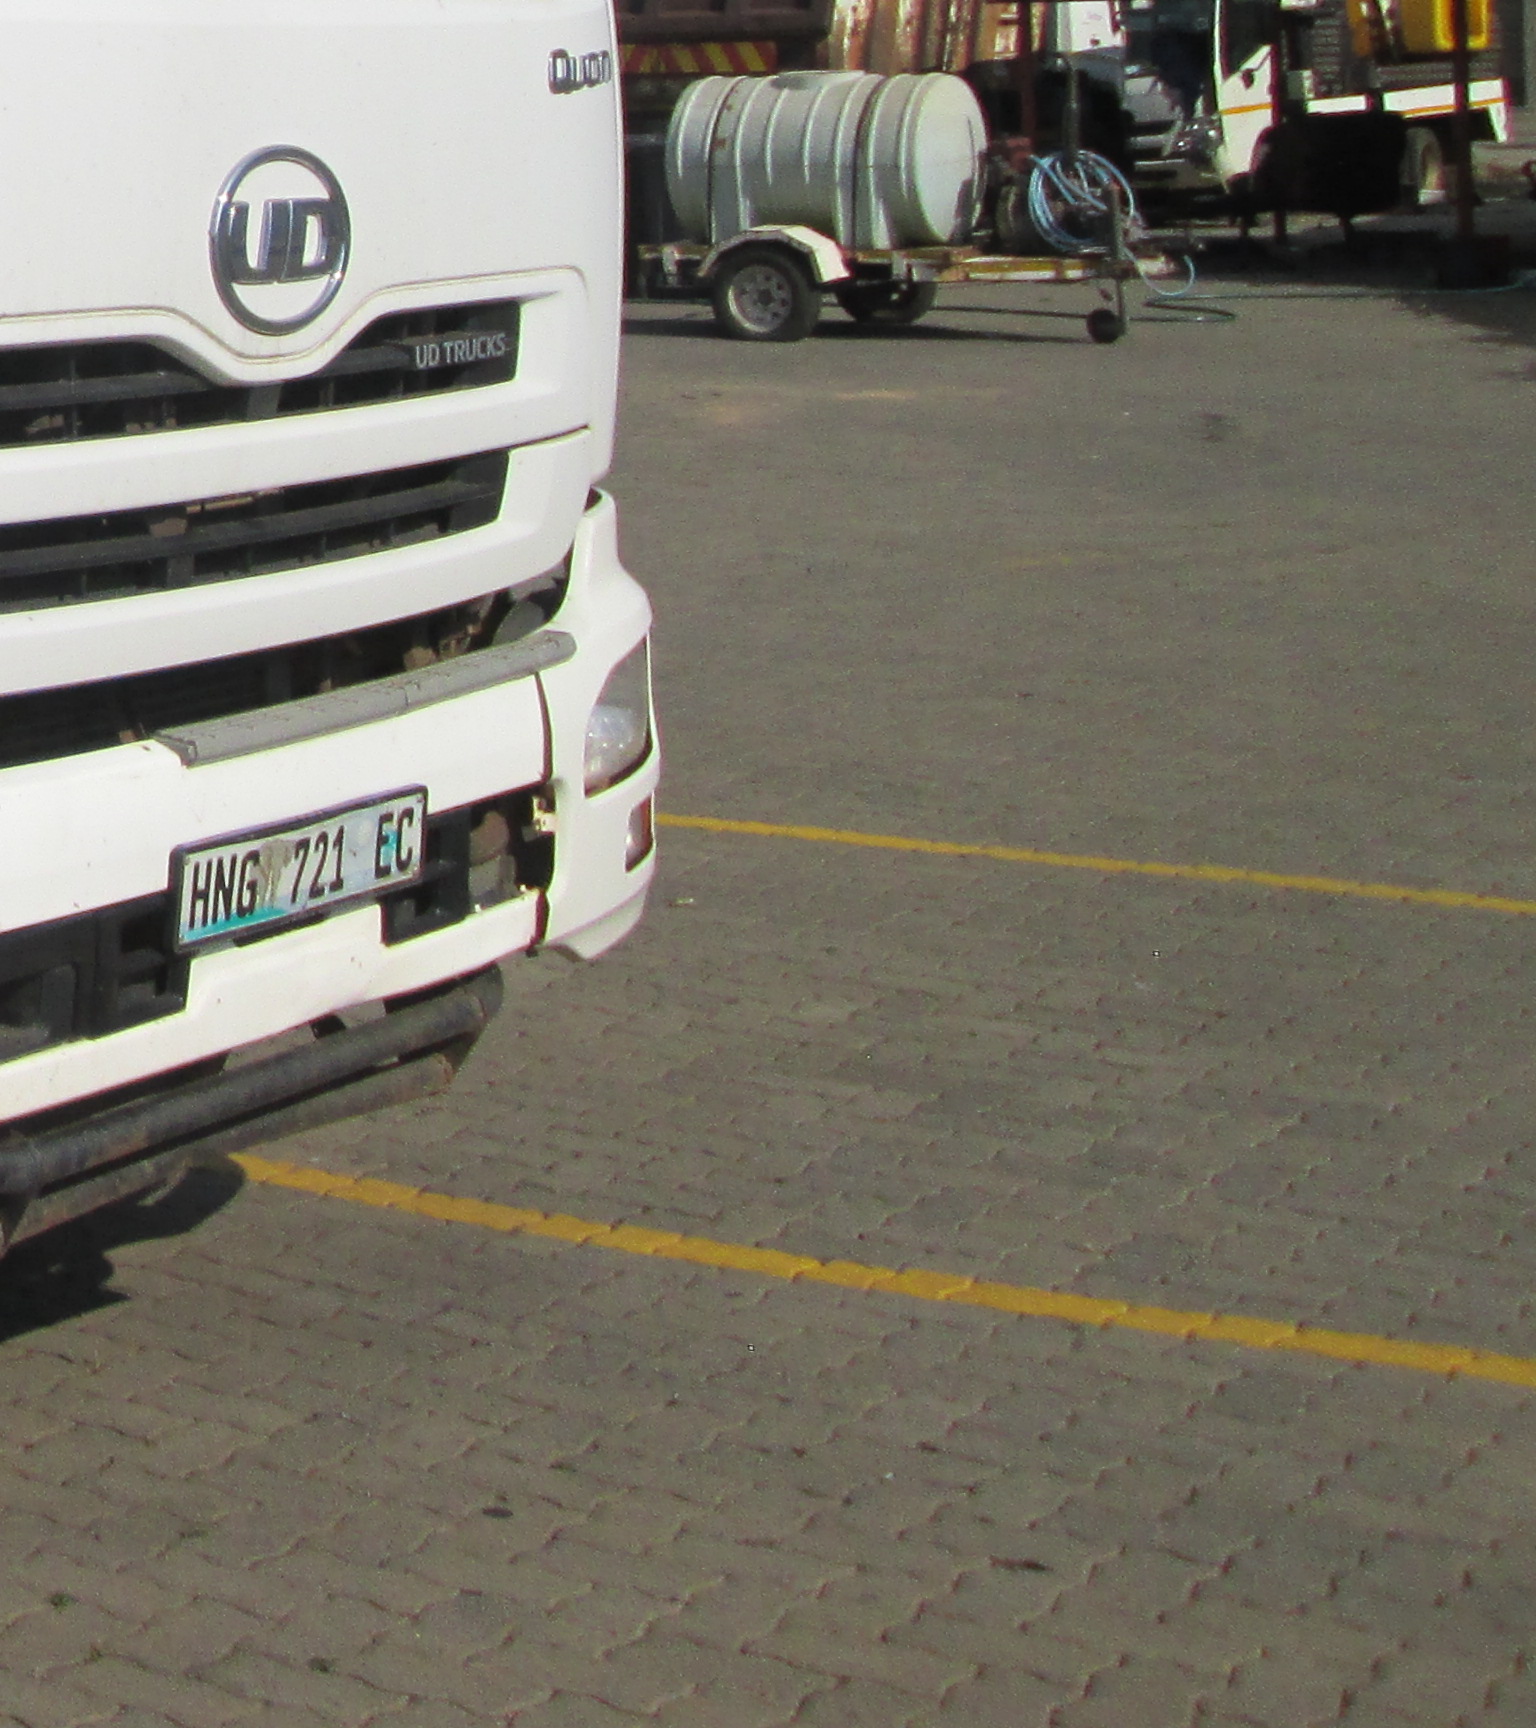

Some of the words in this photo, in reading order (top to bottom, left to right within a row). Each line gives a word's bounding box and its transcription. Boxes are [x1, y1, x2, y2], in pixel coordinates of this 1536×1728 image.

[225, 198, 340, 284] UD
[415, 344, 440, 369] UD
[443, 333, 506, 364] TRUCKS
[189, 849, 261, 929] HNG
[290, 825, 345, 904] 721
[374, 807, 415, 879] EC
